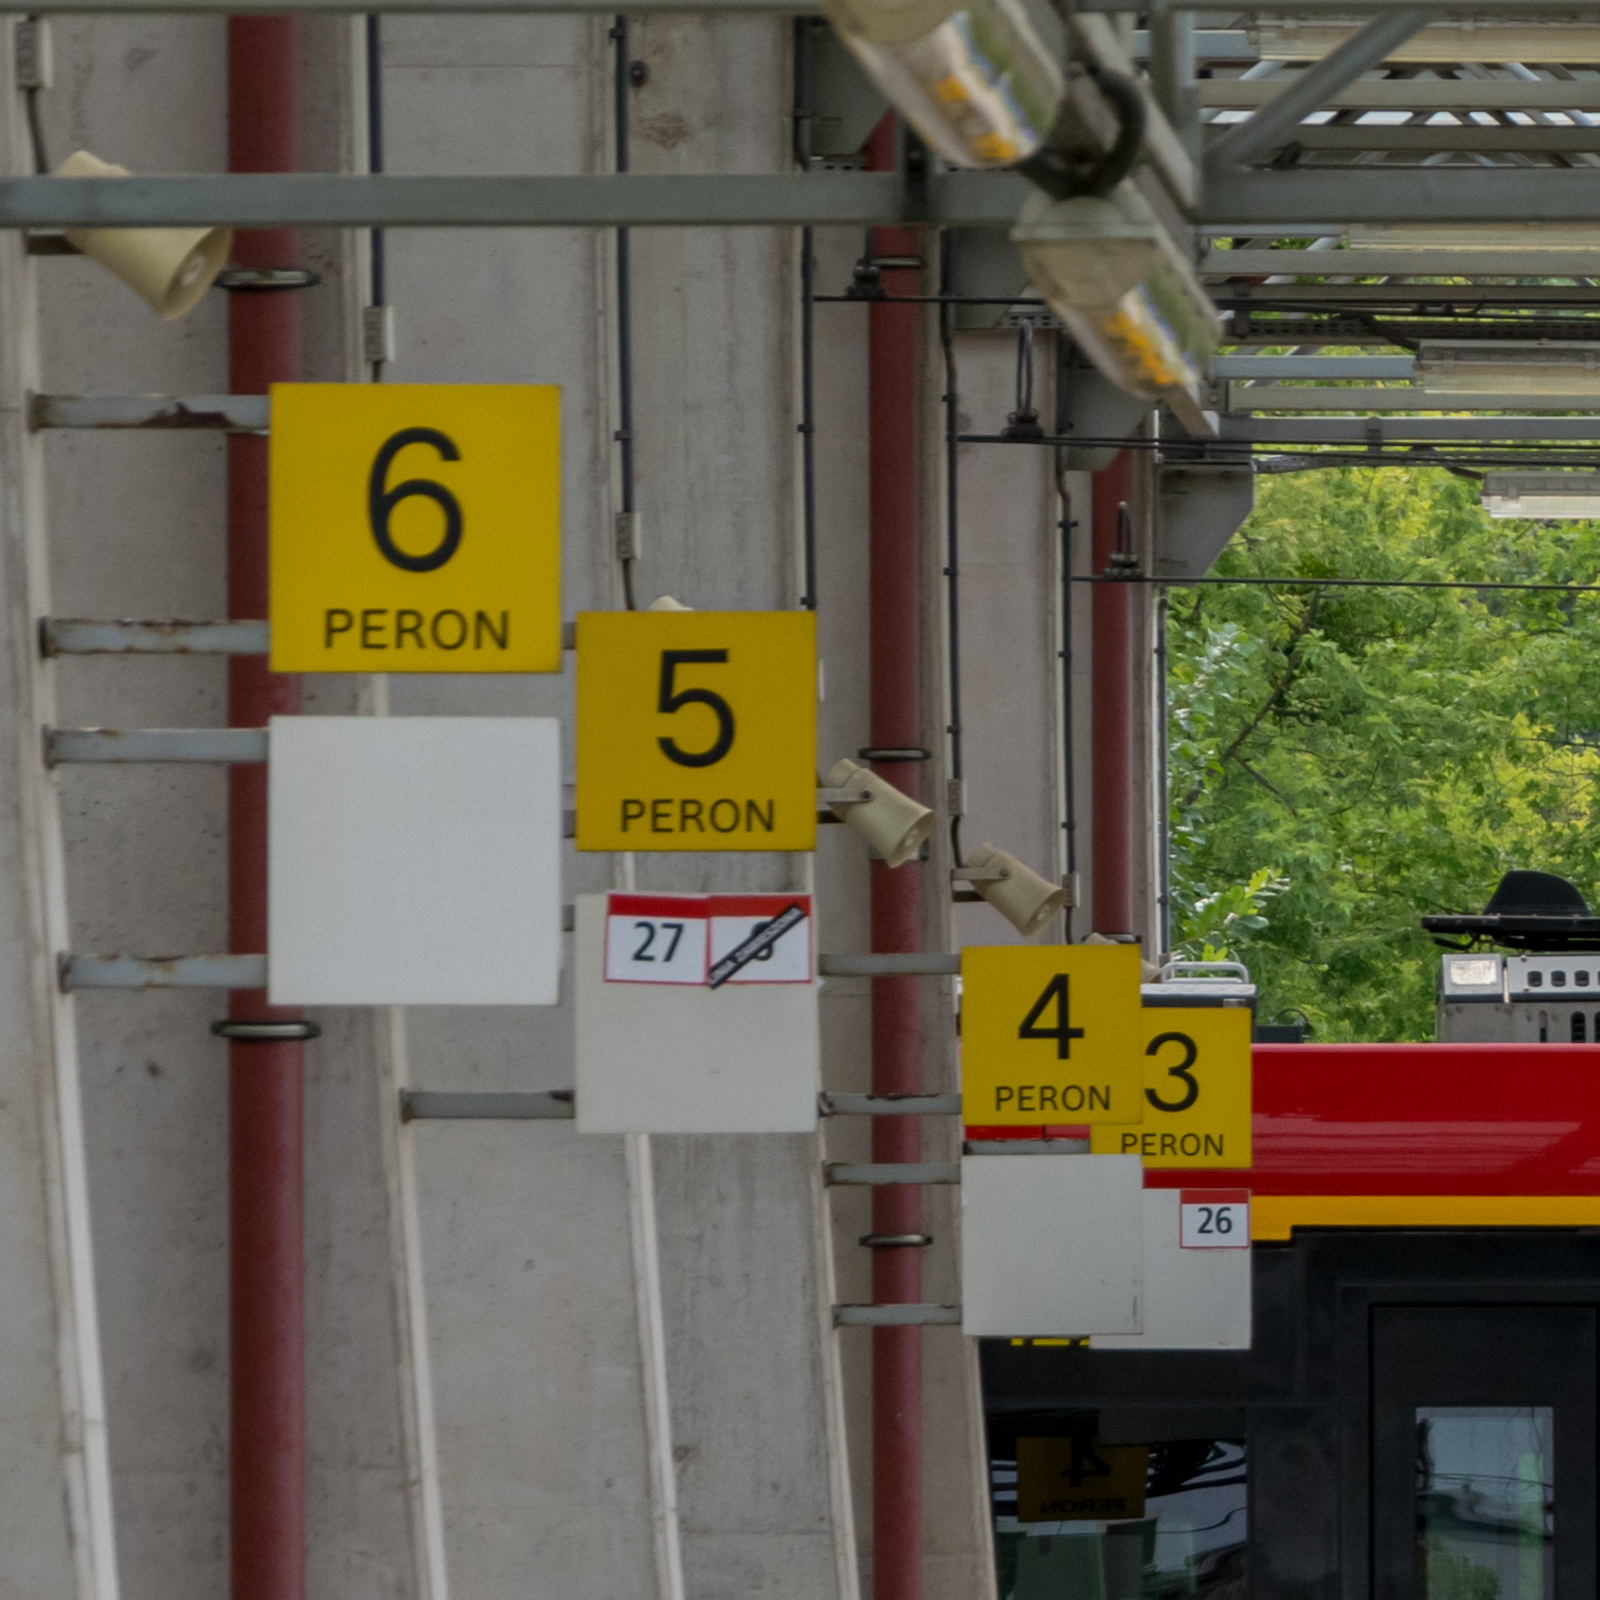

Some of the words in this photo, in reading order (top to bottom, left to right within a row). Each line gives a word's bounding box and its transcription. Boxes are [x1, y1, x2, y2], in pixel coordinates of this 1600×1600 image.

[368, 427, 463, 572] 6
[325, 609, 509, 650] PERON
[656, 649, 735, 768] 5
[621, 799, 774, 833] PERON
[632, 920, 684, 962] 27
[1018, 974, 1085, 1060] 4
[1145, 1032, 1199, 1112] 3
[995, 1085, 1110, 1112] PERON
[1121, 1133, 1224, 1156] PERON
[1198, 1206, 1232, 1234] 26
